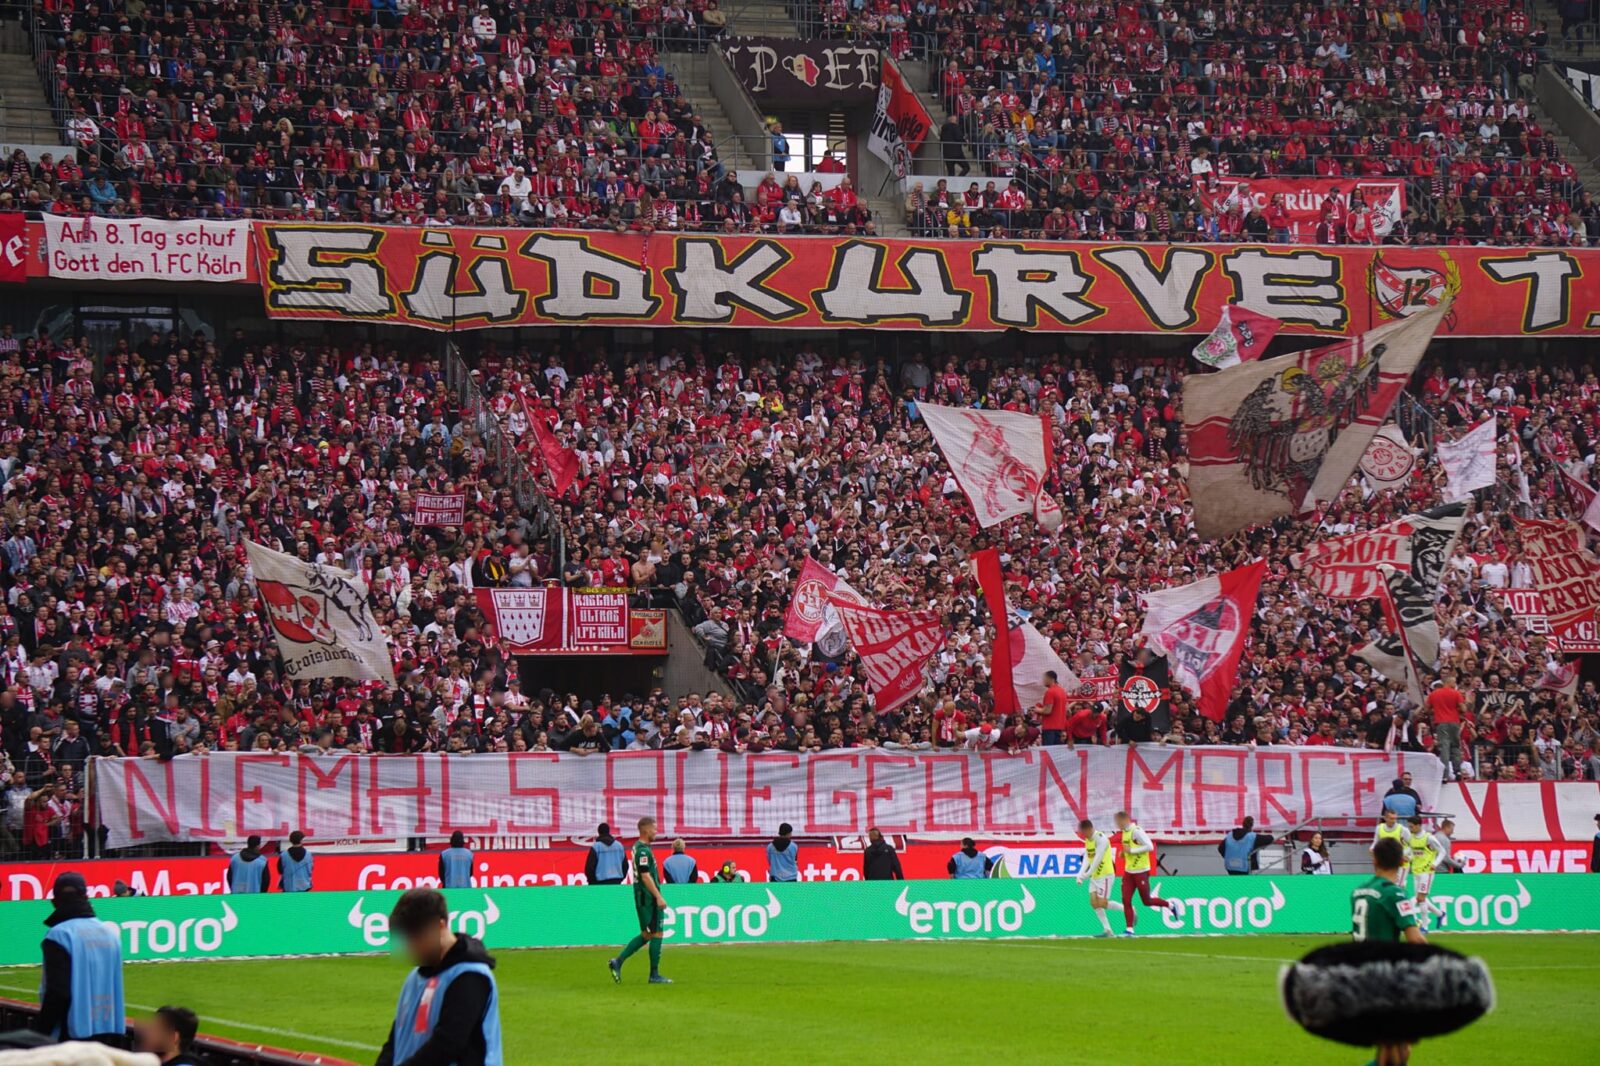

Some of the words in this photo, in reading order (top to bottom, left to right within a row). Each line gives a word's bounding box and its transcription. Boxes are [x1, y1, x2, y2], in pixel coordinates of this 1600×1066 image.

[60, 221, 97, 243] Am
[106, 224, 124, 245] 8.
[129, 223, 166, 250] Tag
[176, 224, 236, 246] schuf
[54, 250, 100, 272] Gott
[107, 252, 144, 273] den
[168, 253, 192, 273] FC
[197, 252, 242, 275] Köln
[265, 224, 1349, 333] SÜDKURVE
[1402, 277, 1431, 306] 12
[580, 609, 620, 622] ULTRAS
[122, 752, 561, 840] NIEMALS
[602, 746, 1088, 837] AUFGEBEN
[1018, 853, 1083, 876] NAB
